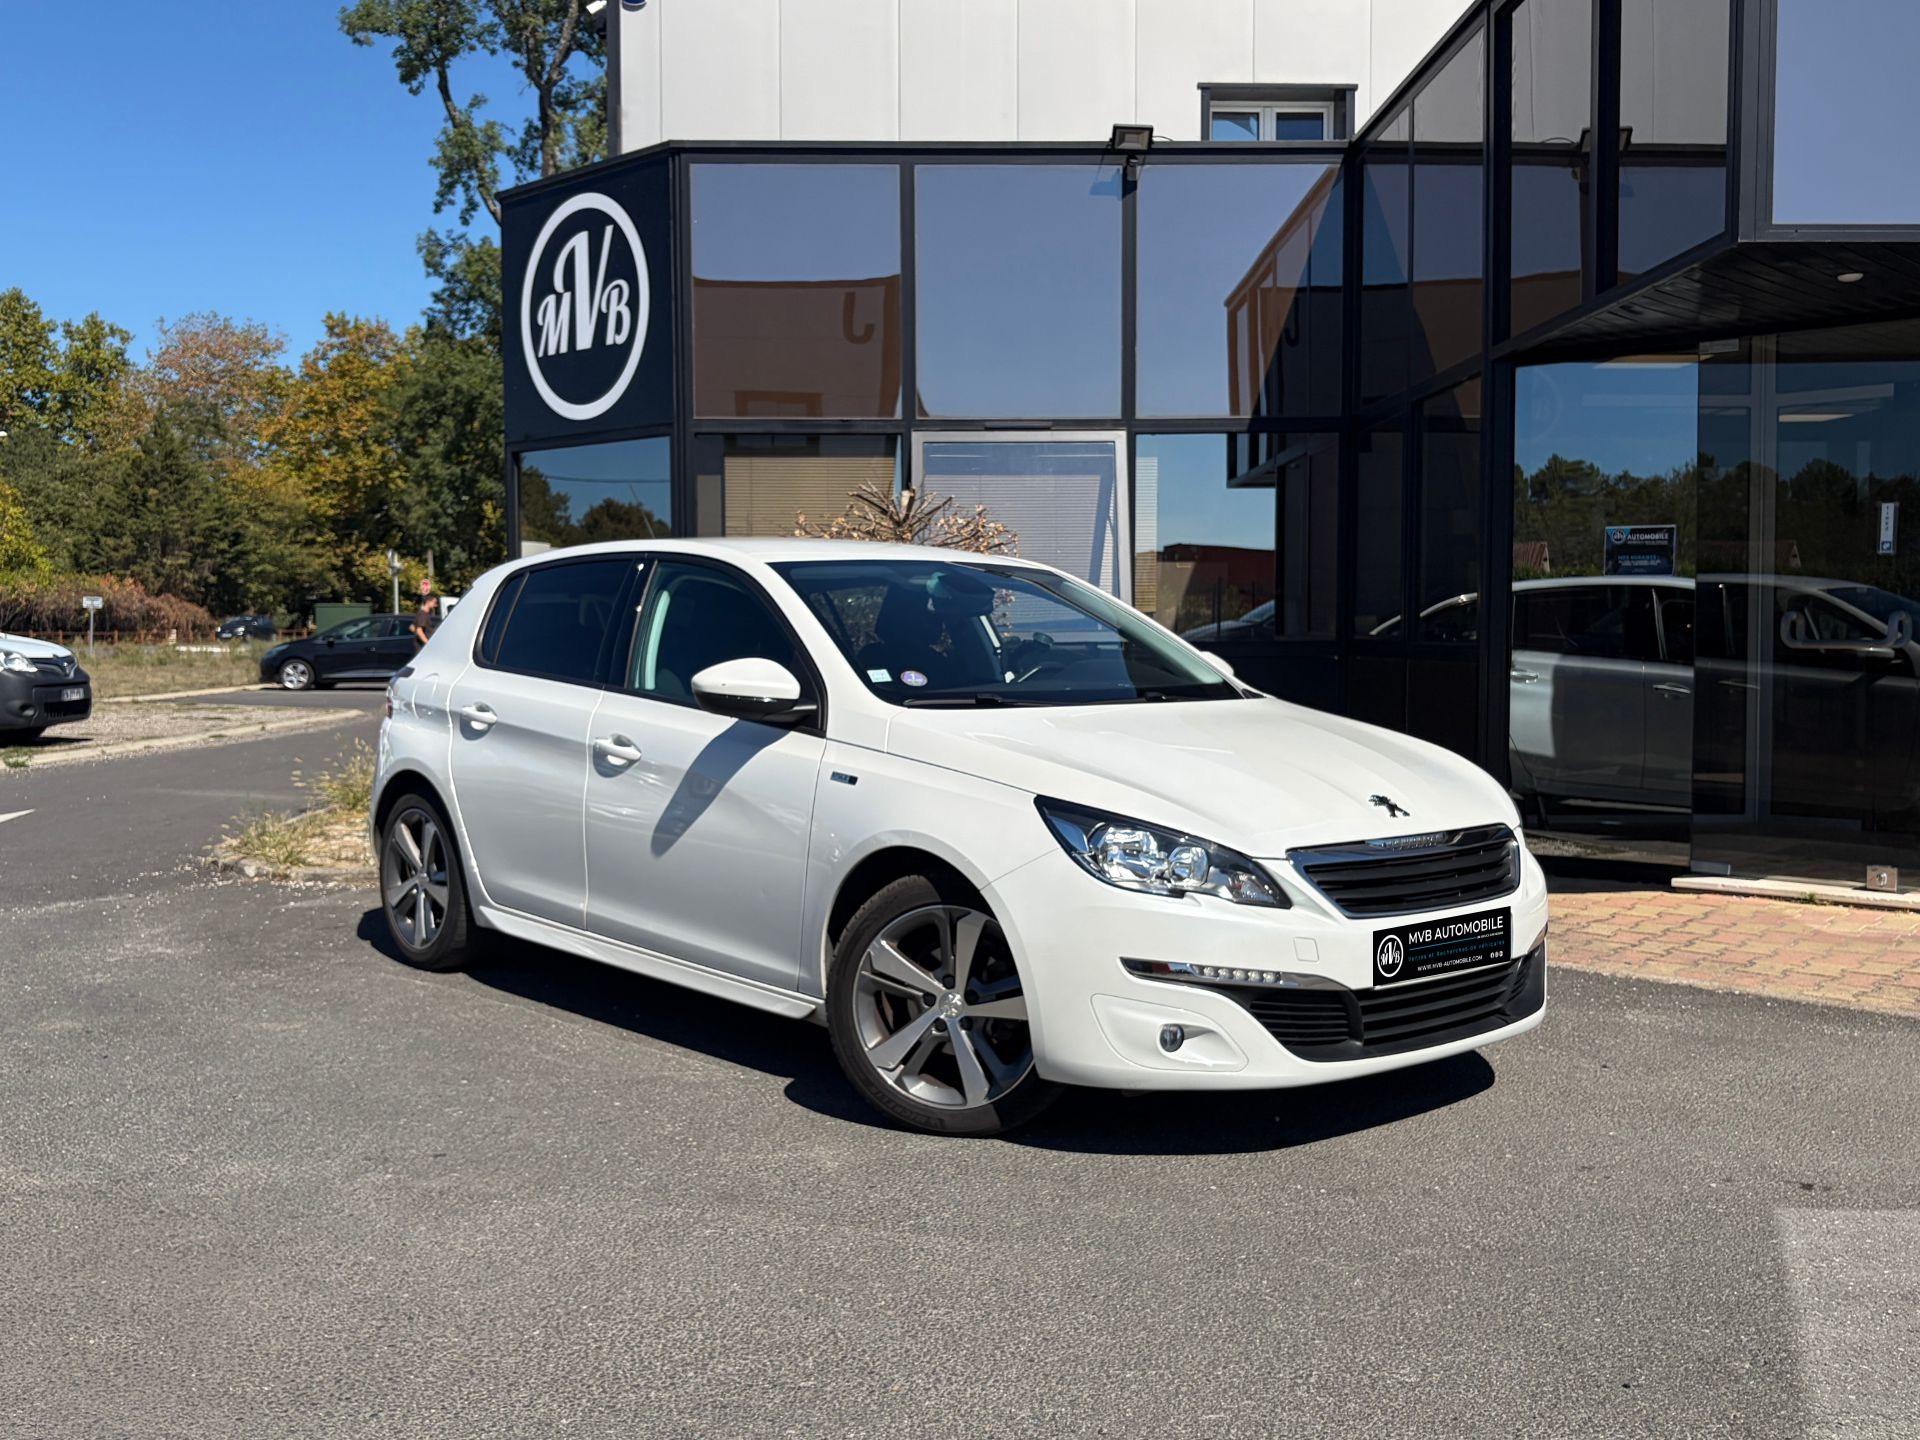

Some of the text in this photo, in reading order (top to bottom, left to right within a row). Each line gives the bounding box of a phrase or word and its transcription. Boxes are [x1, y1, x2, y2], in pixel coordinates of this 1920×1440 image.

[537, 224, 631, 358] MVB
[1627, 532, 1669, 540] AUTOMOBILE
[1408, 916, 1504, 945] MVB AUTOMOBILE
